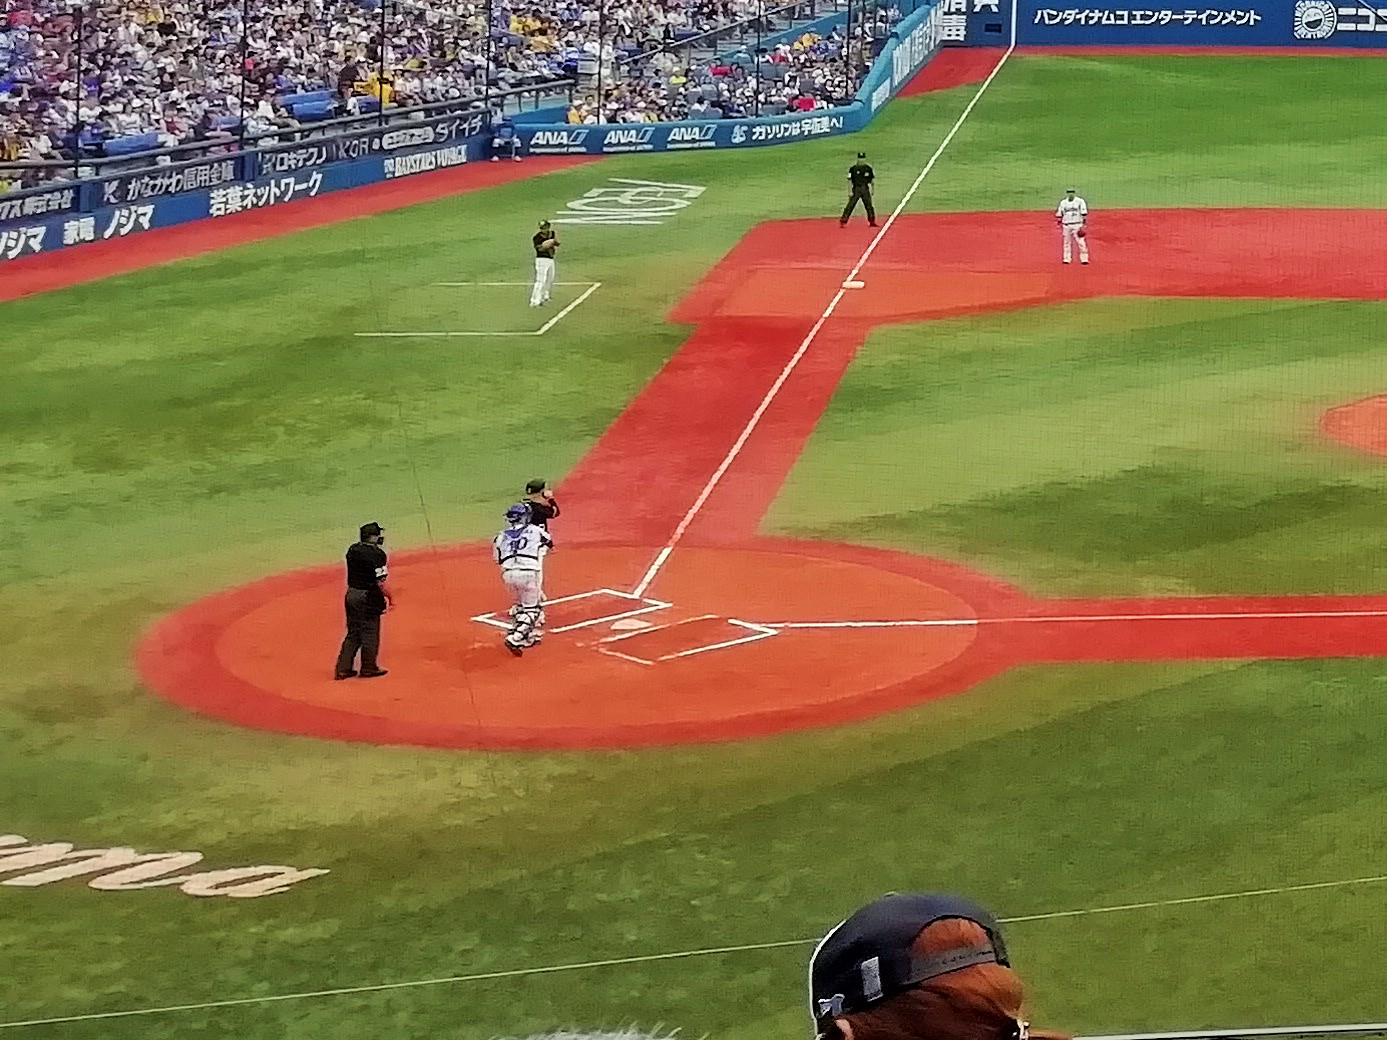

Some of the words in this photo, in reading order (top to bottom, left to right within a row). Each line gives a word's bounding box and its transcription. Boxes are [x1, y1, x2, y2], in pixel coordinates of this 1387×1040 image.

[530, 131, 568, 145] ANA
[603, 130, 637, 144] ANA
[667, 127, 700, 141] ANA
[209, 171, 323, 218] 若葉ネットワーク
